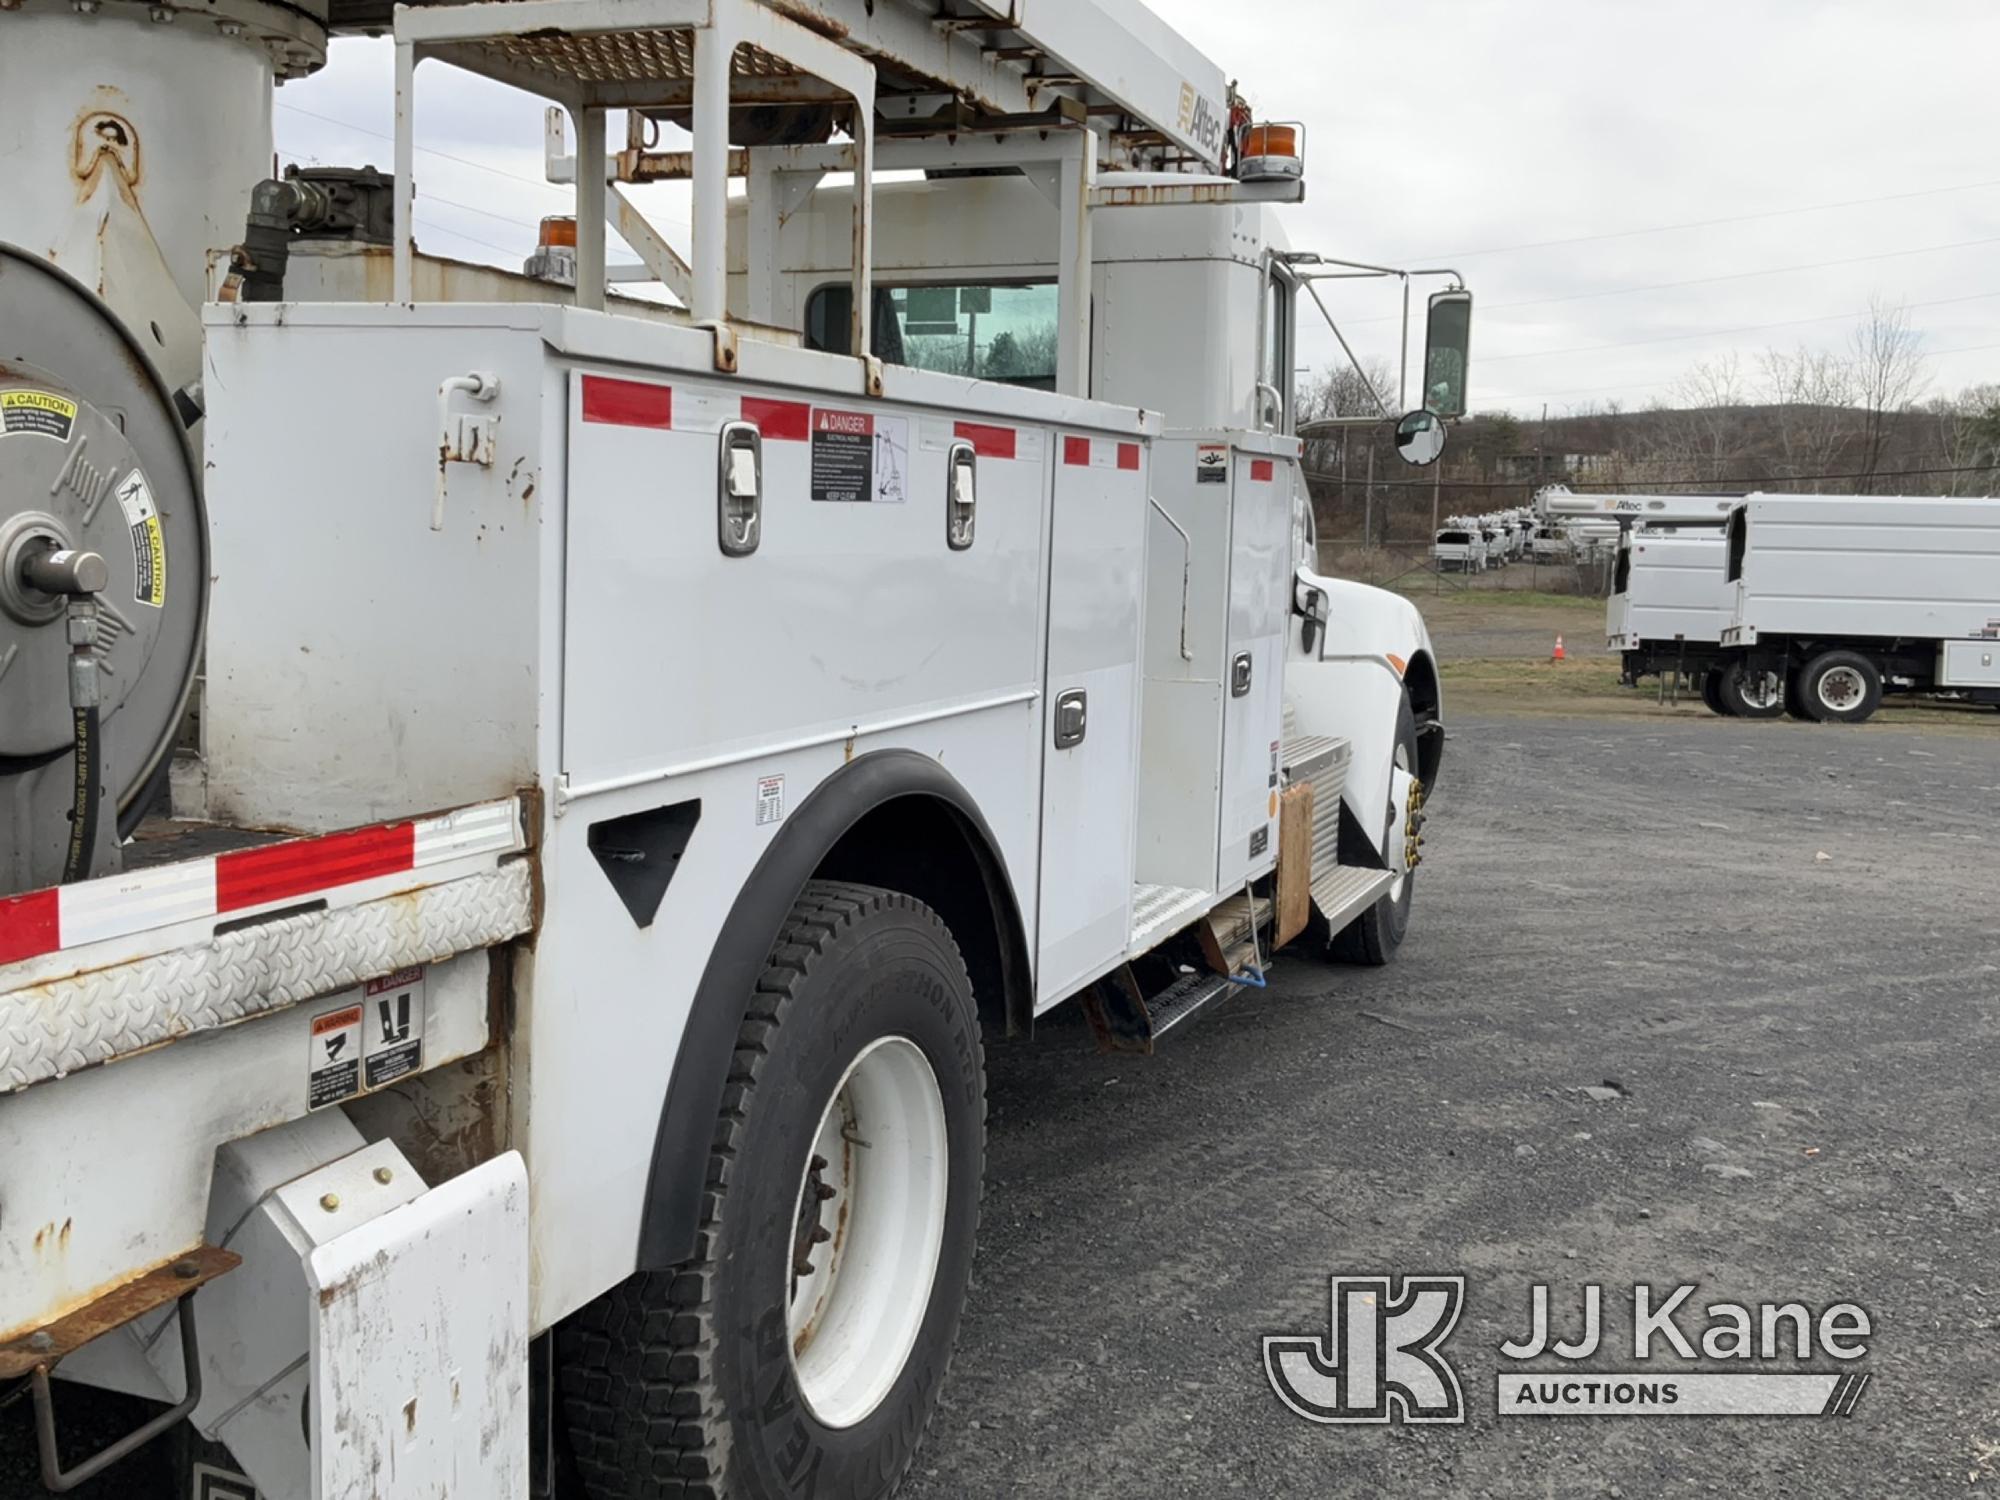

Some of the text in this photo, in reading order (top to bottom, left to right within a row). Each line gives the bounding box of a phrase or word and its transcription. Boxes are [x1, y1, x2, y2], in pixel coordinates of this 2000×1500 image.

[1189, 94, 1220, 153] Altec
[17, 394, 69, 413] CAUTION
[830, 413, 865, 432] DANGER
[152, 536, 161, 597] CAUTION
[383, 967, 420, 988] DANGER
